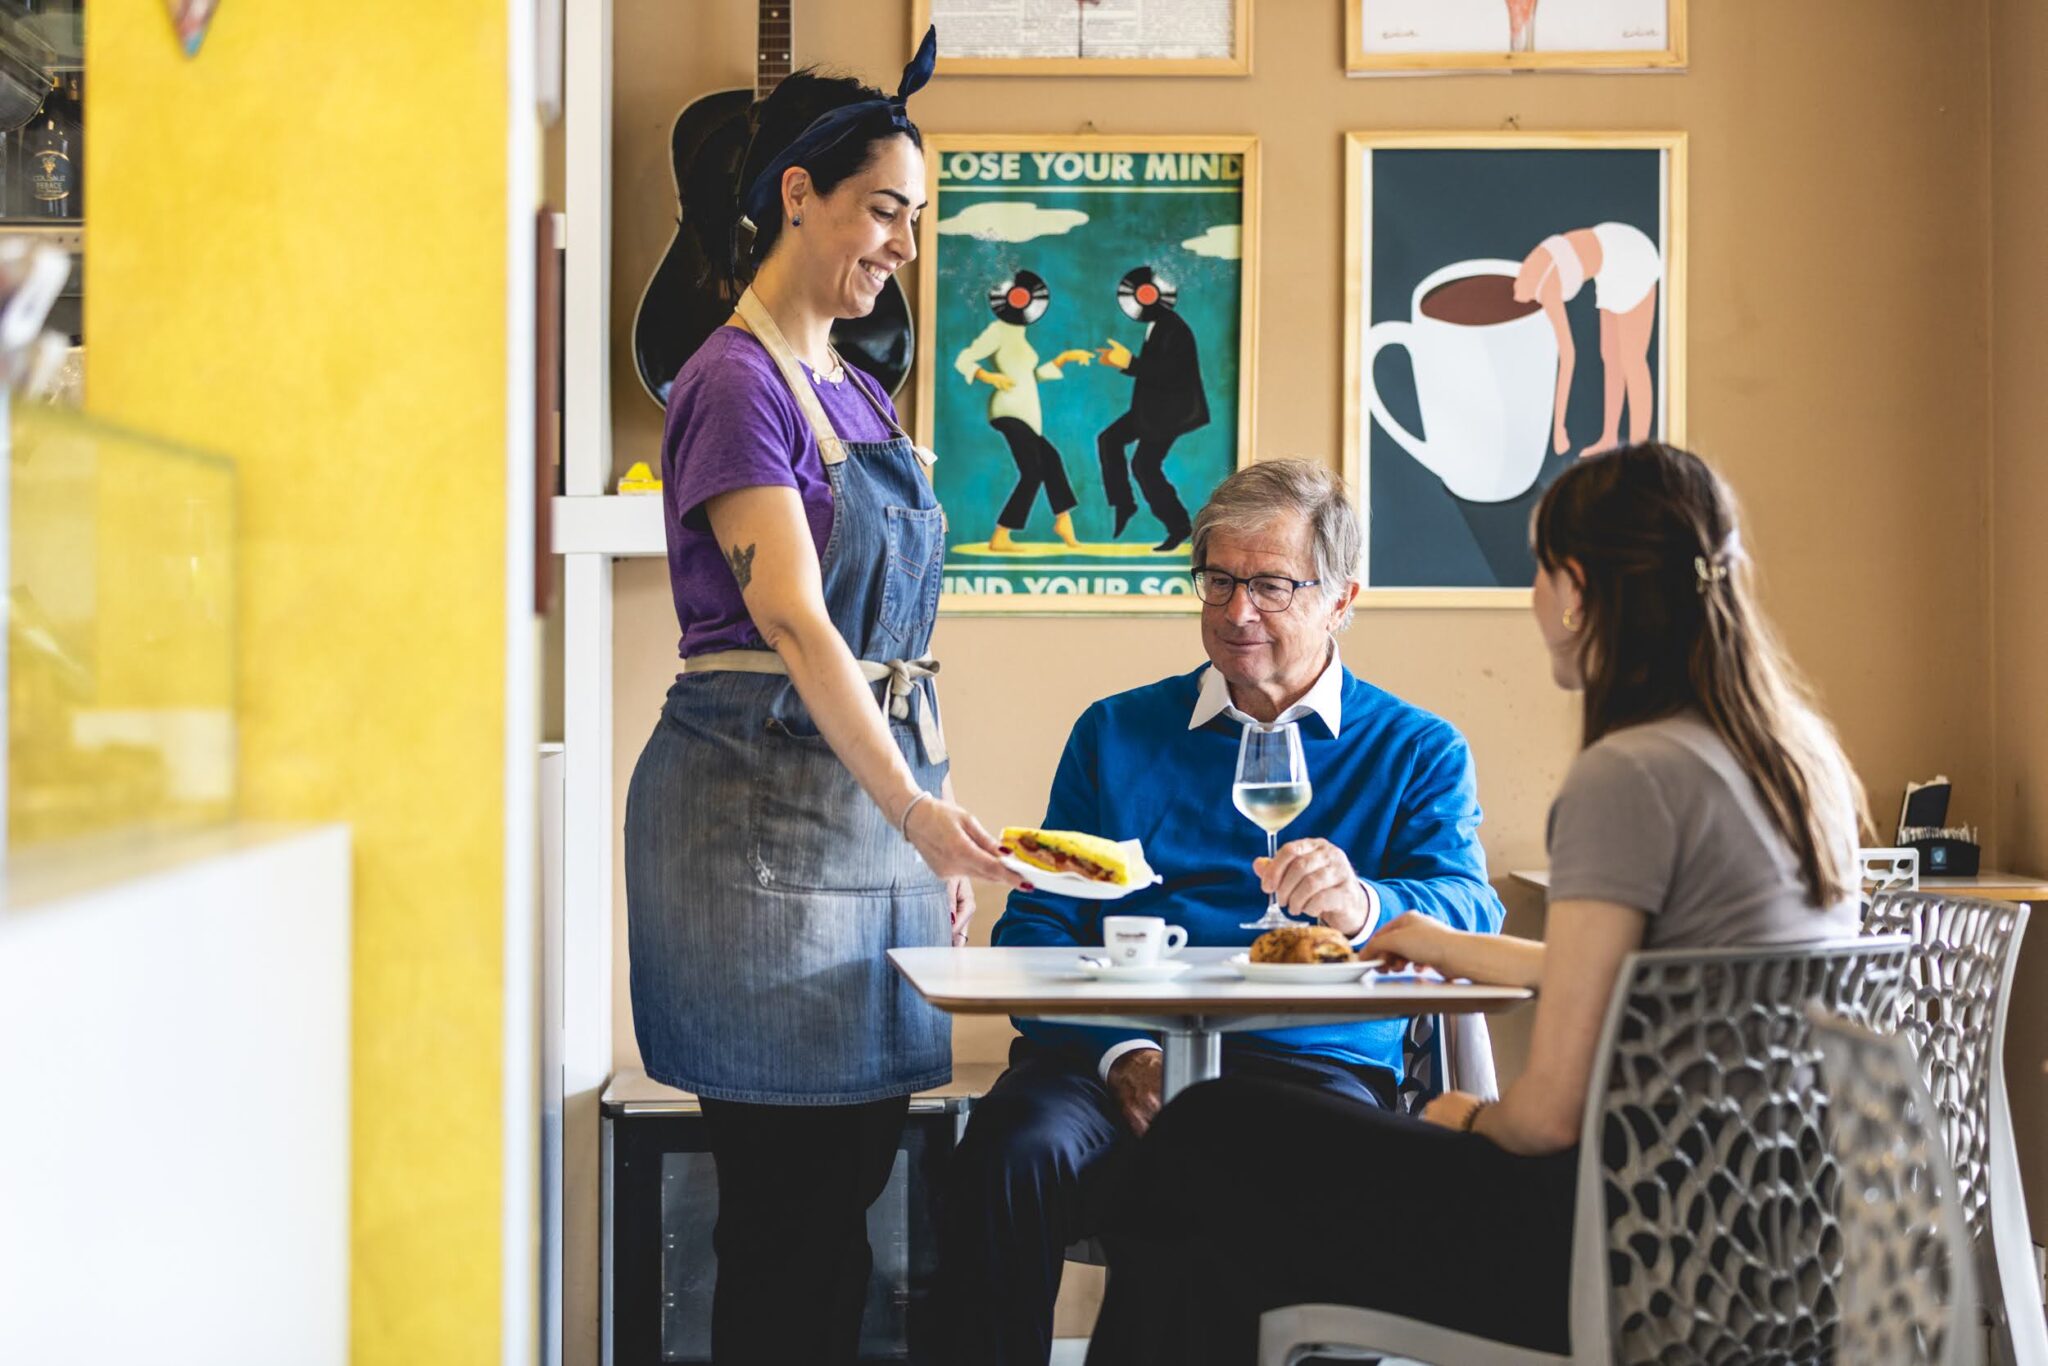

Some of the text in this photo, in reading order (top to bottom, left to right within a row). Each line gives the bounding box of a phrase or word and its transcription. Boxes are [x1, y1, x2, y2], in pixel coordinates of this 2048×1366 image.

[939, 153, 1242, 181] LOSE YOUR MIND
[942, 576, 1193, 595] IND YOUR SO
